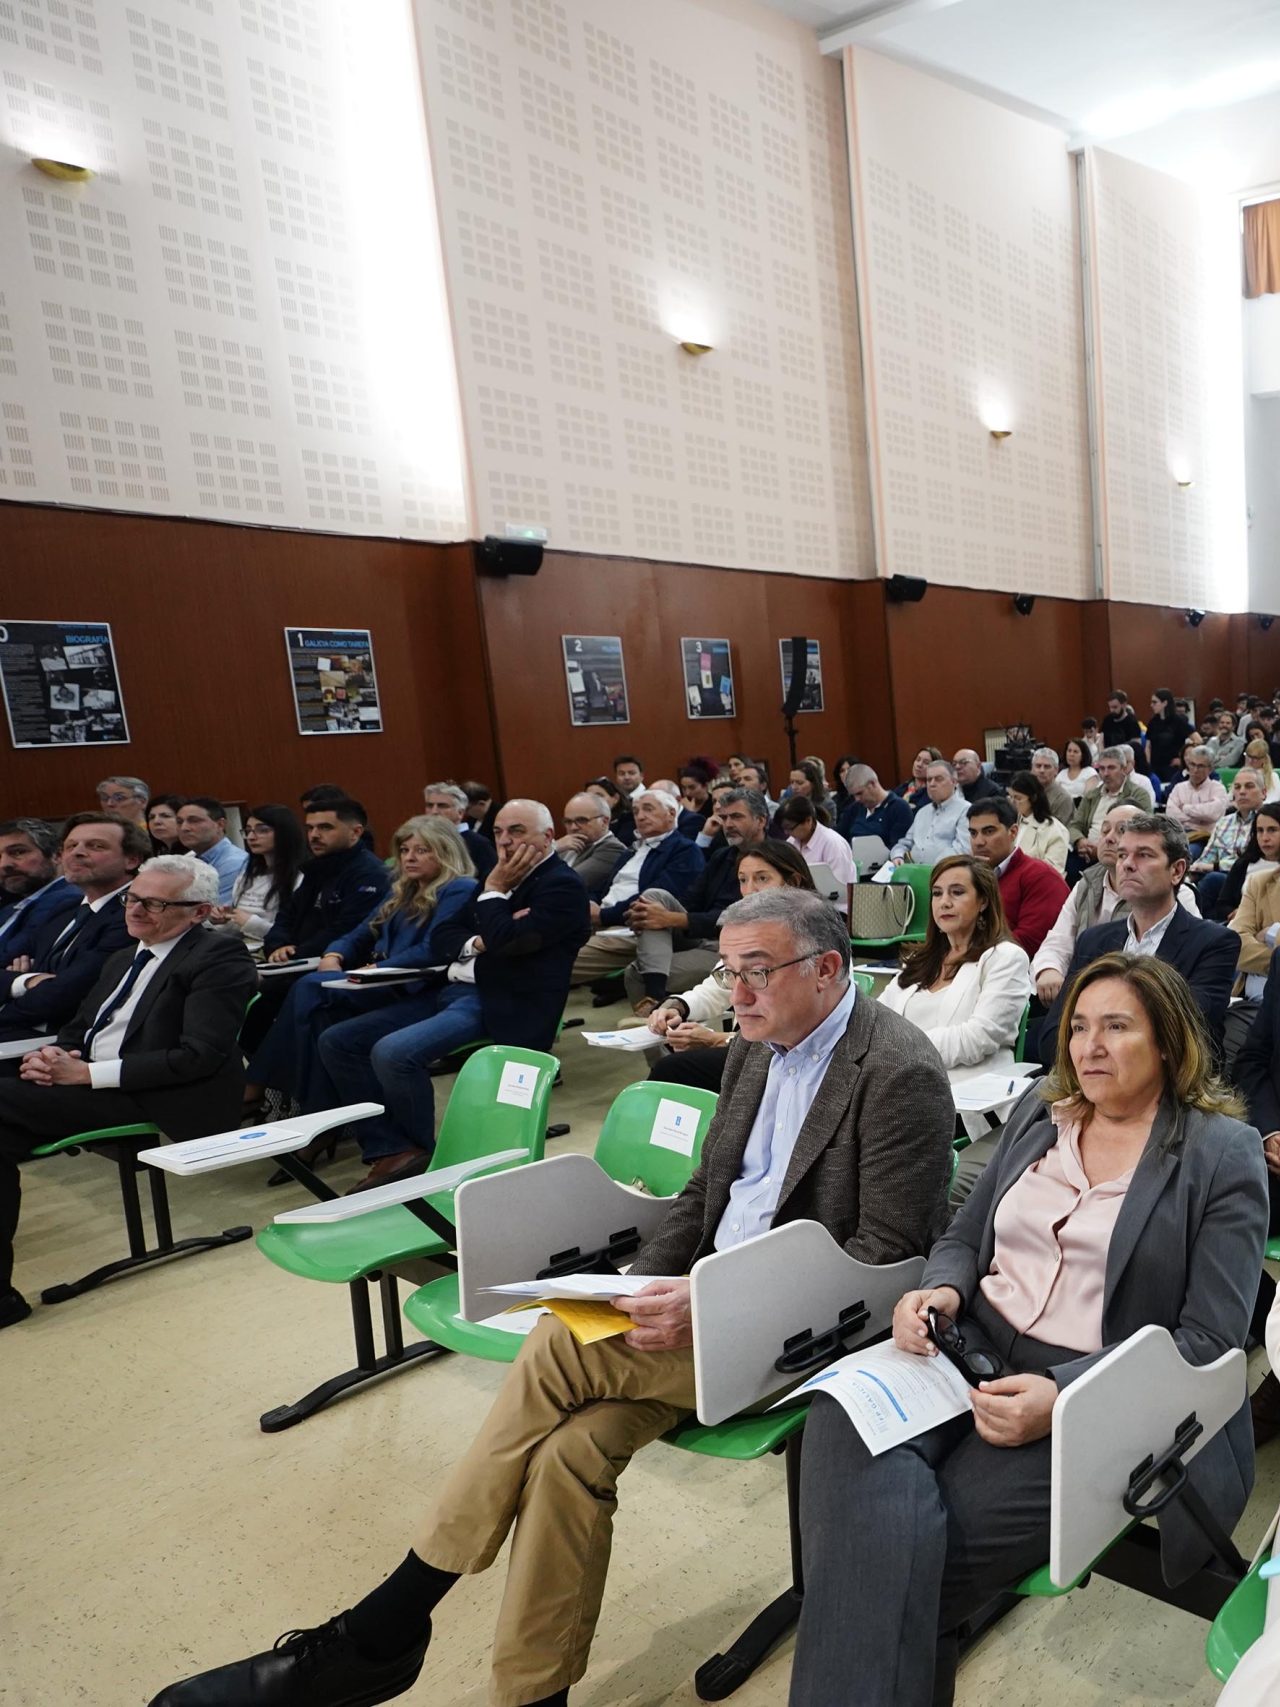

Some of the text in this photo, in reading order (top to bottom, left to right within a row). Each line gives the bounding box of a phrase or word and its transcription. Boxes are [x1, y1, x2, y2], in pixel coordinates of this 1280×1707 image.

[297, 632, 304, 647] 1
[574, 639, 583, 652] 2
[695, 641, 703, 654] 3
